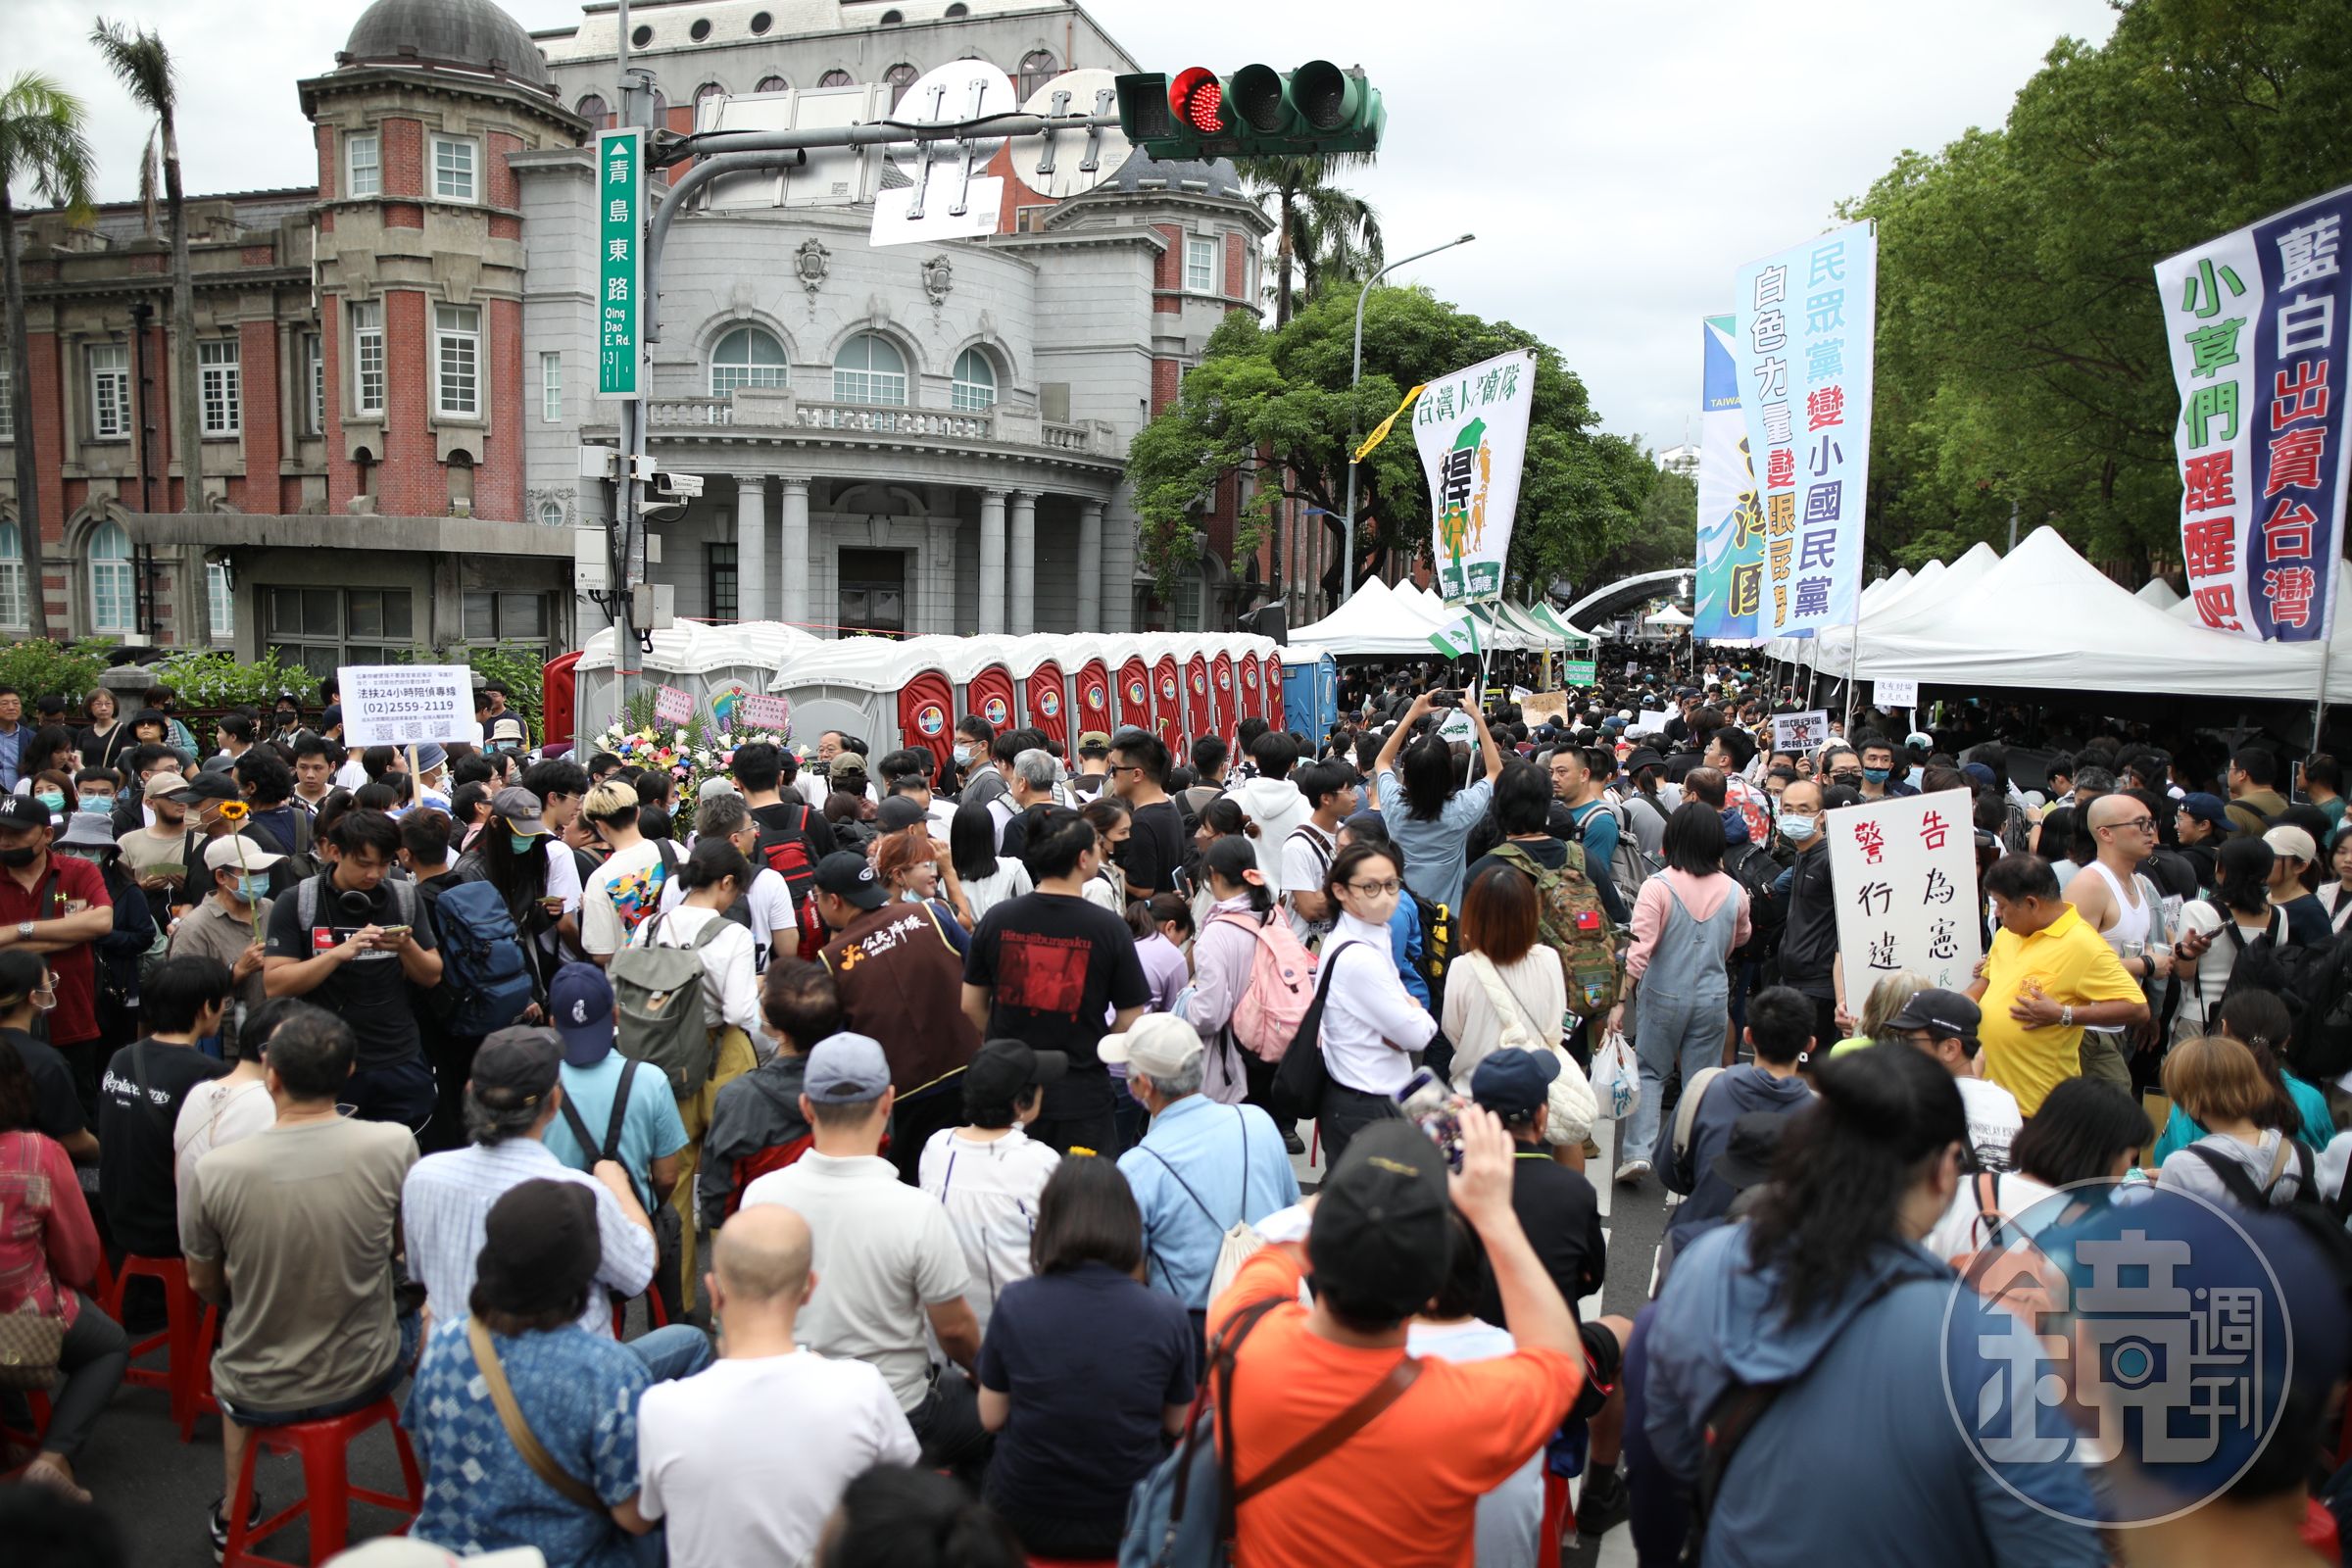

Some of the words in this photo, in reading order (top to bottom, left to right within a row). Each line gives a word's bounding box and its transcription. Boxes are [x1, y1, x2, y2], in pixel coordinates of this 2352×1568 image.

[608, 159, 629, 302] 青島東路
[605, 307, 625, 321] Qing
[605, 320, 622, 333] Dao
[605, 334, 613, 346] E.
[615, 334, 630, 346] Rd.
[1710, 395, 1742, 409] TAIWA
[2263, 213, 2342, 629] 藍白出賣台灣
[1794, 240, 1846, 619] 民眾黨變小國民黨
[1441, 447, 1474, 513] 捍
[364, 700, 454, 714] (02)2559-2119
[1853, 809, 1950, 865] 警告
[1857, 867, 1955, 917] 行為
[1867, 917, 1959, 970] 違憲
